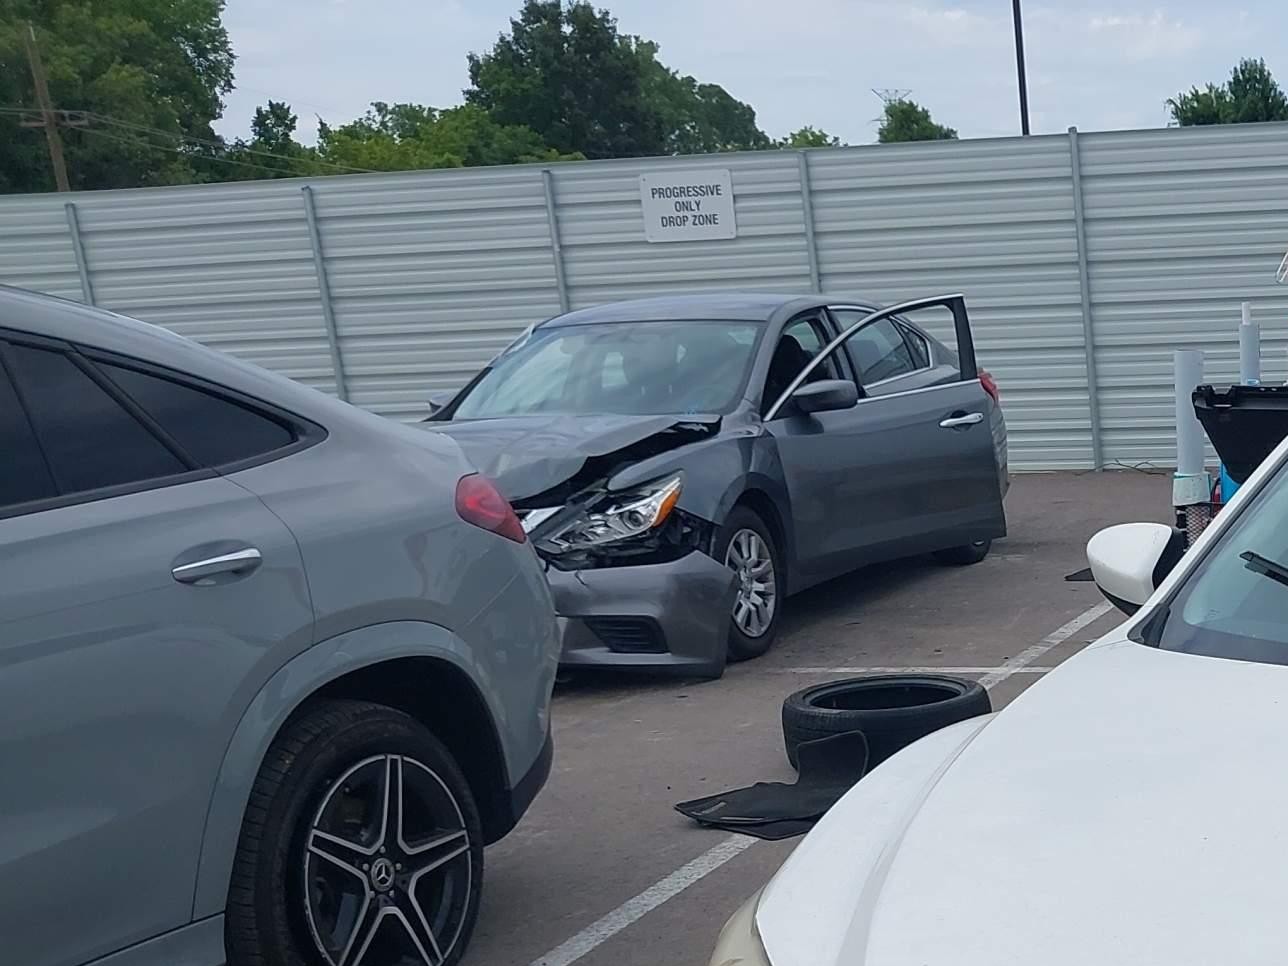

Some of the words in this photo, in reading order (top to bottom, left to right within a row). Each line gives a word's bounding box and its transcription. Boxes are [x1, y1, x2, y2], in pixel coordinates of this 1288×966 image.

[651, 184, 723, 199] PROGRESSIVE
[674, 200, 701, 212] ONLY
[661, 215, 689, 227] DROP
[692, 213, 719, 226] ZONE
